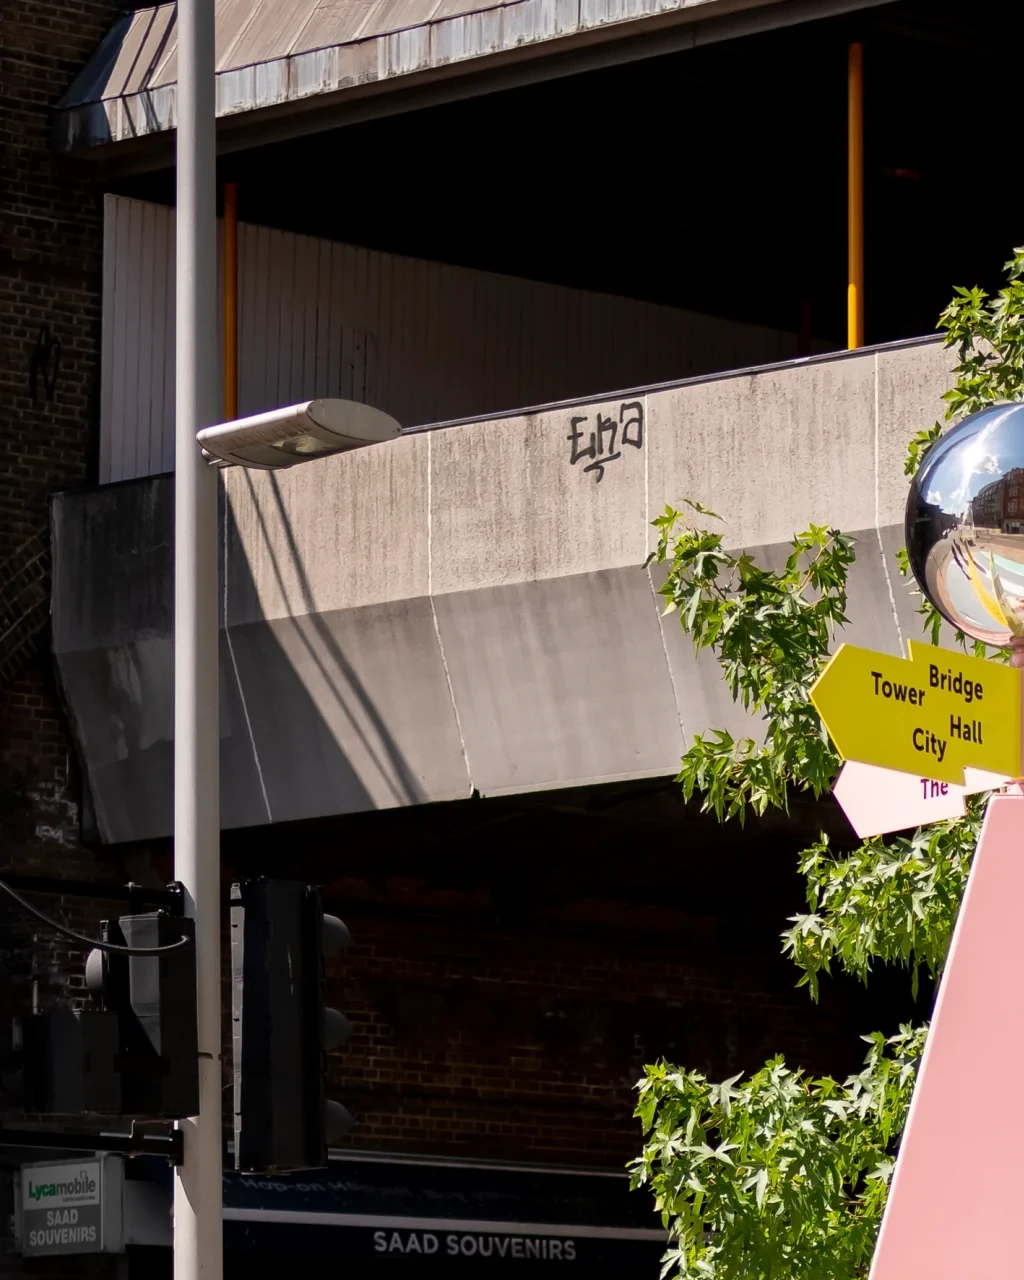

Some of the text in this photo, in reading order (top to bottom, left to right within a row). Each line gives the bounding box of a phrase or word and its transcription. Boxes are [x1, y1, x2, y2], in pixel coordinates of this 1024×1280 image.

[871, 664, 984, 706] Tower Bridge
[912, 714, 983, 762] City Hall
[920, 779, 948, 799] The
[28, 1176, 96, 1201] Lycamobile
[46, 1209, 78, 1226] SAAD
[29, 1226, 96, 1246] SOUVENIRS
[373, 1231, 577, 1261] SAAD SOUVENIRS
